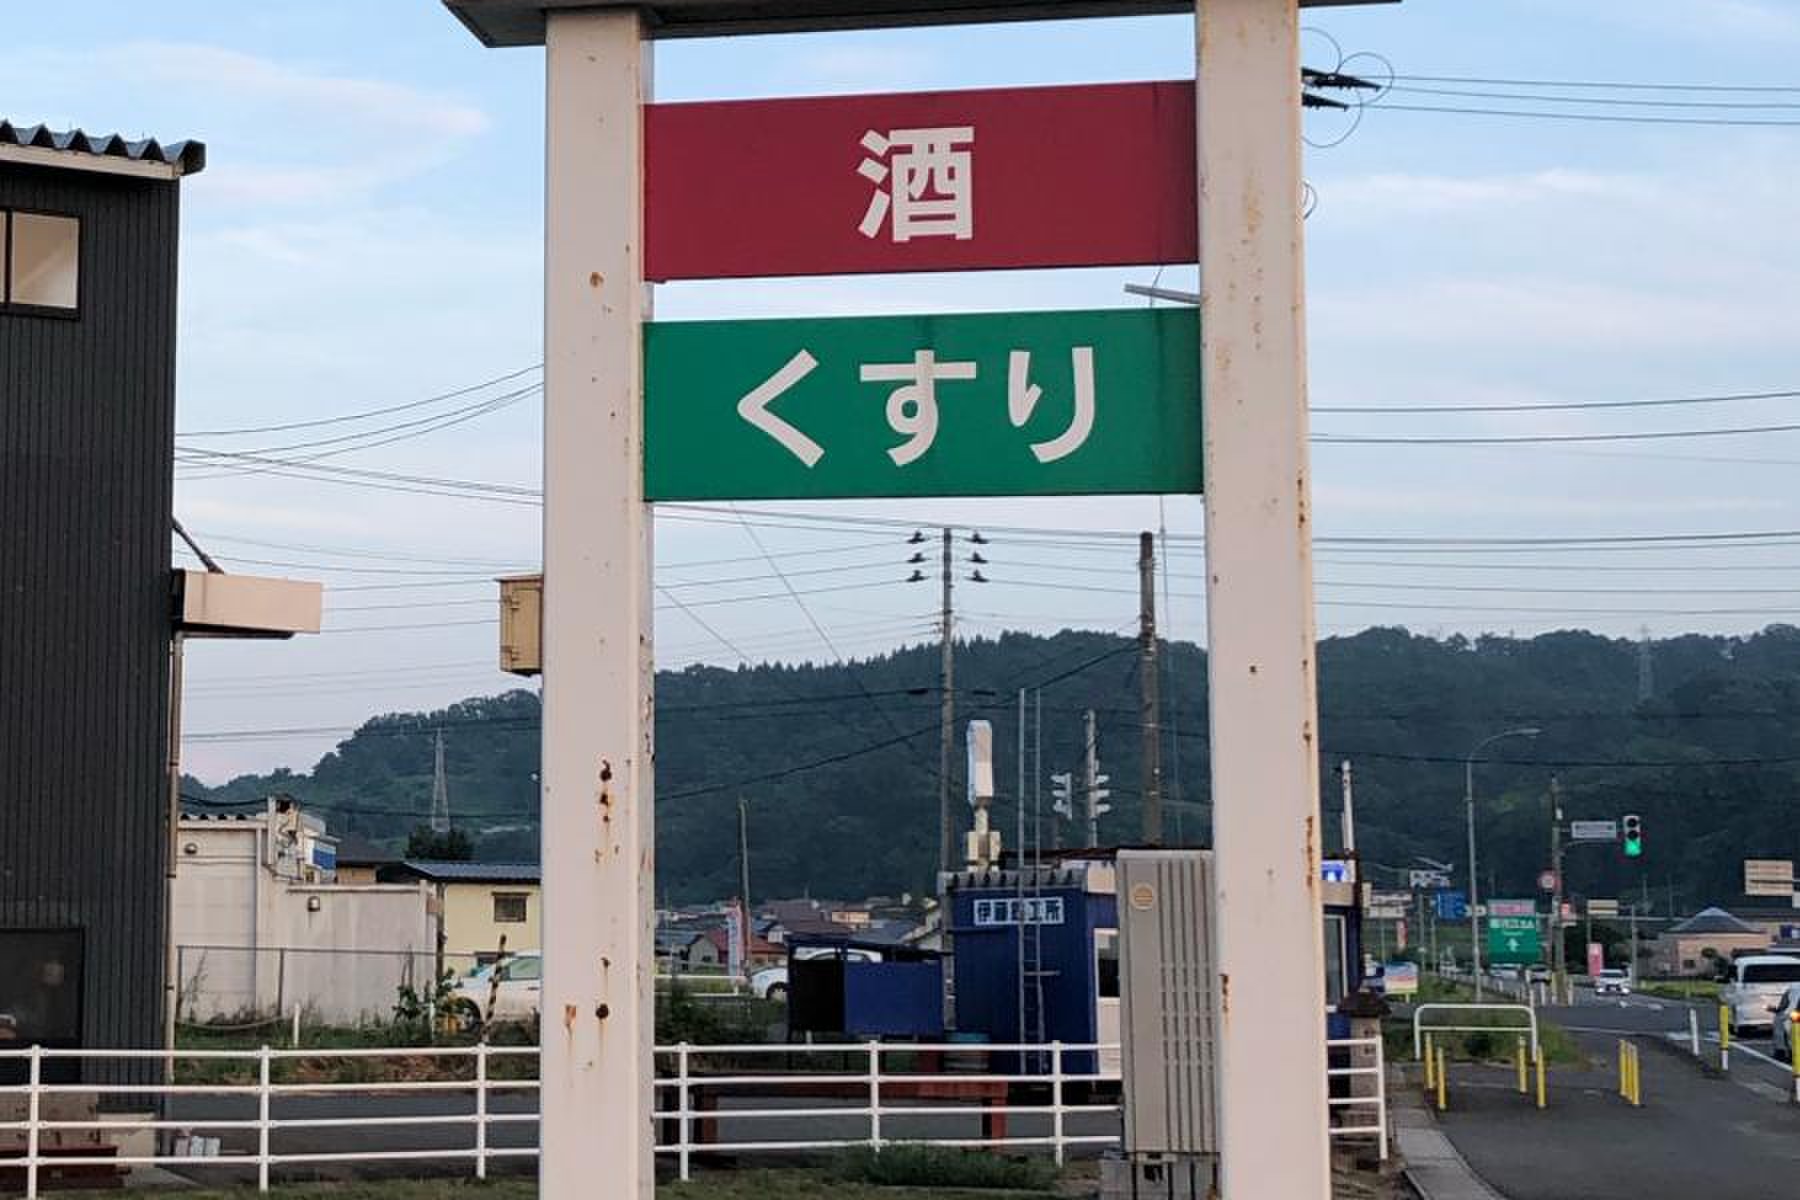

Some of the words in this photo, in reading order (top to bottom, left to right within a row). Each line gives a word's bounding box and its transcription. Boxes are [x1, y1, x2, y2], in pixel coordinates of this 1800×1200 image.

[857, 126, 975, 243] 酒
[737, 346, 1096, 468] くすり
